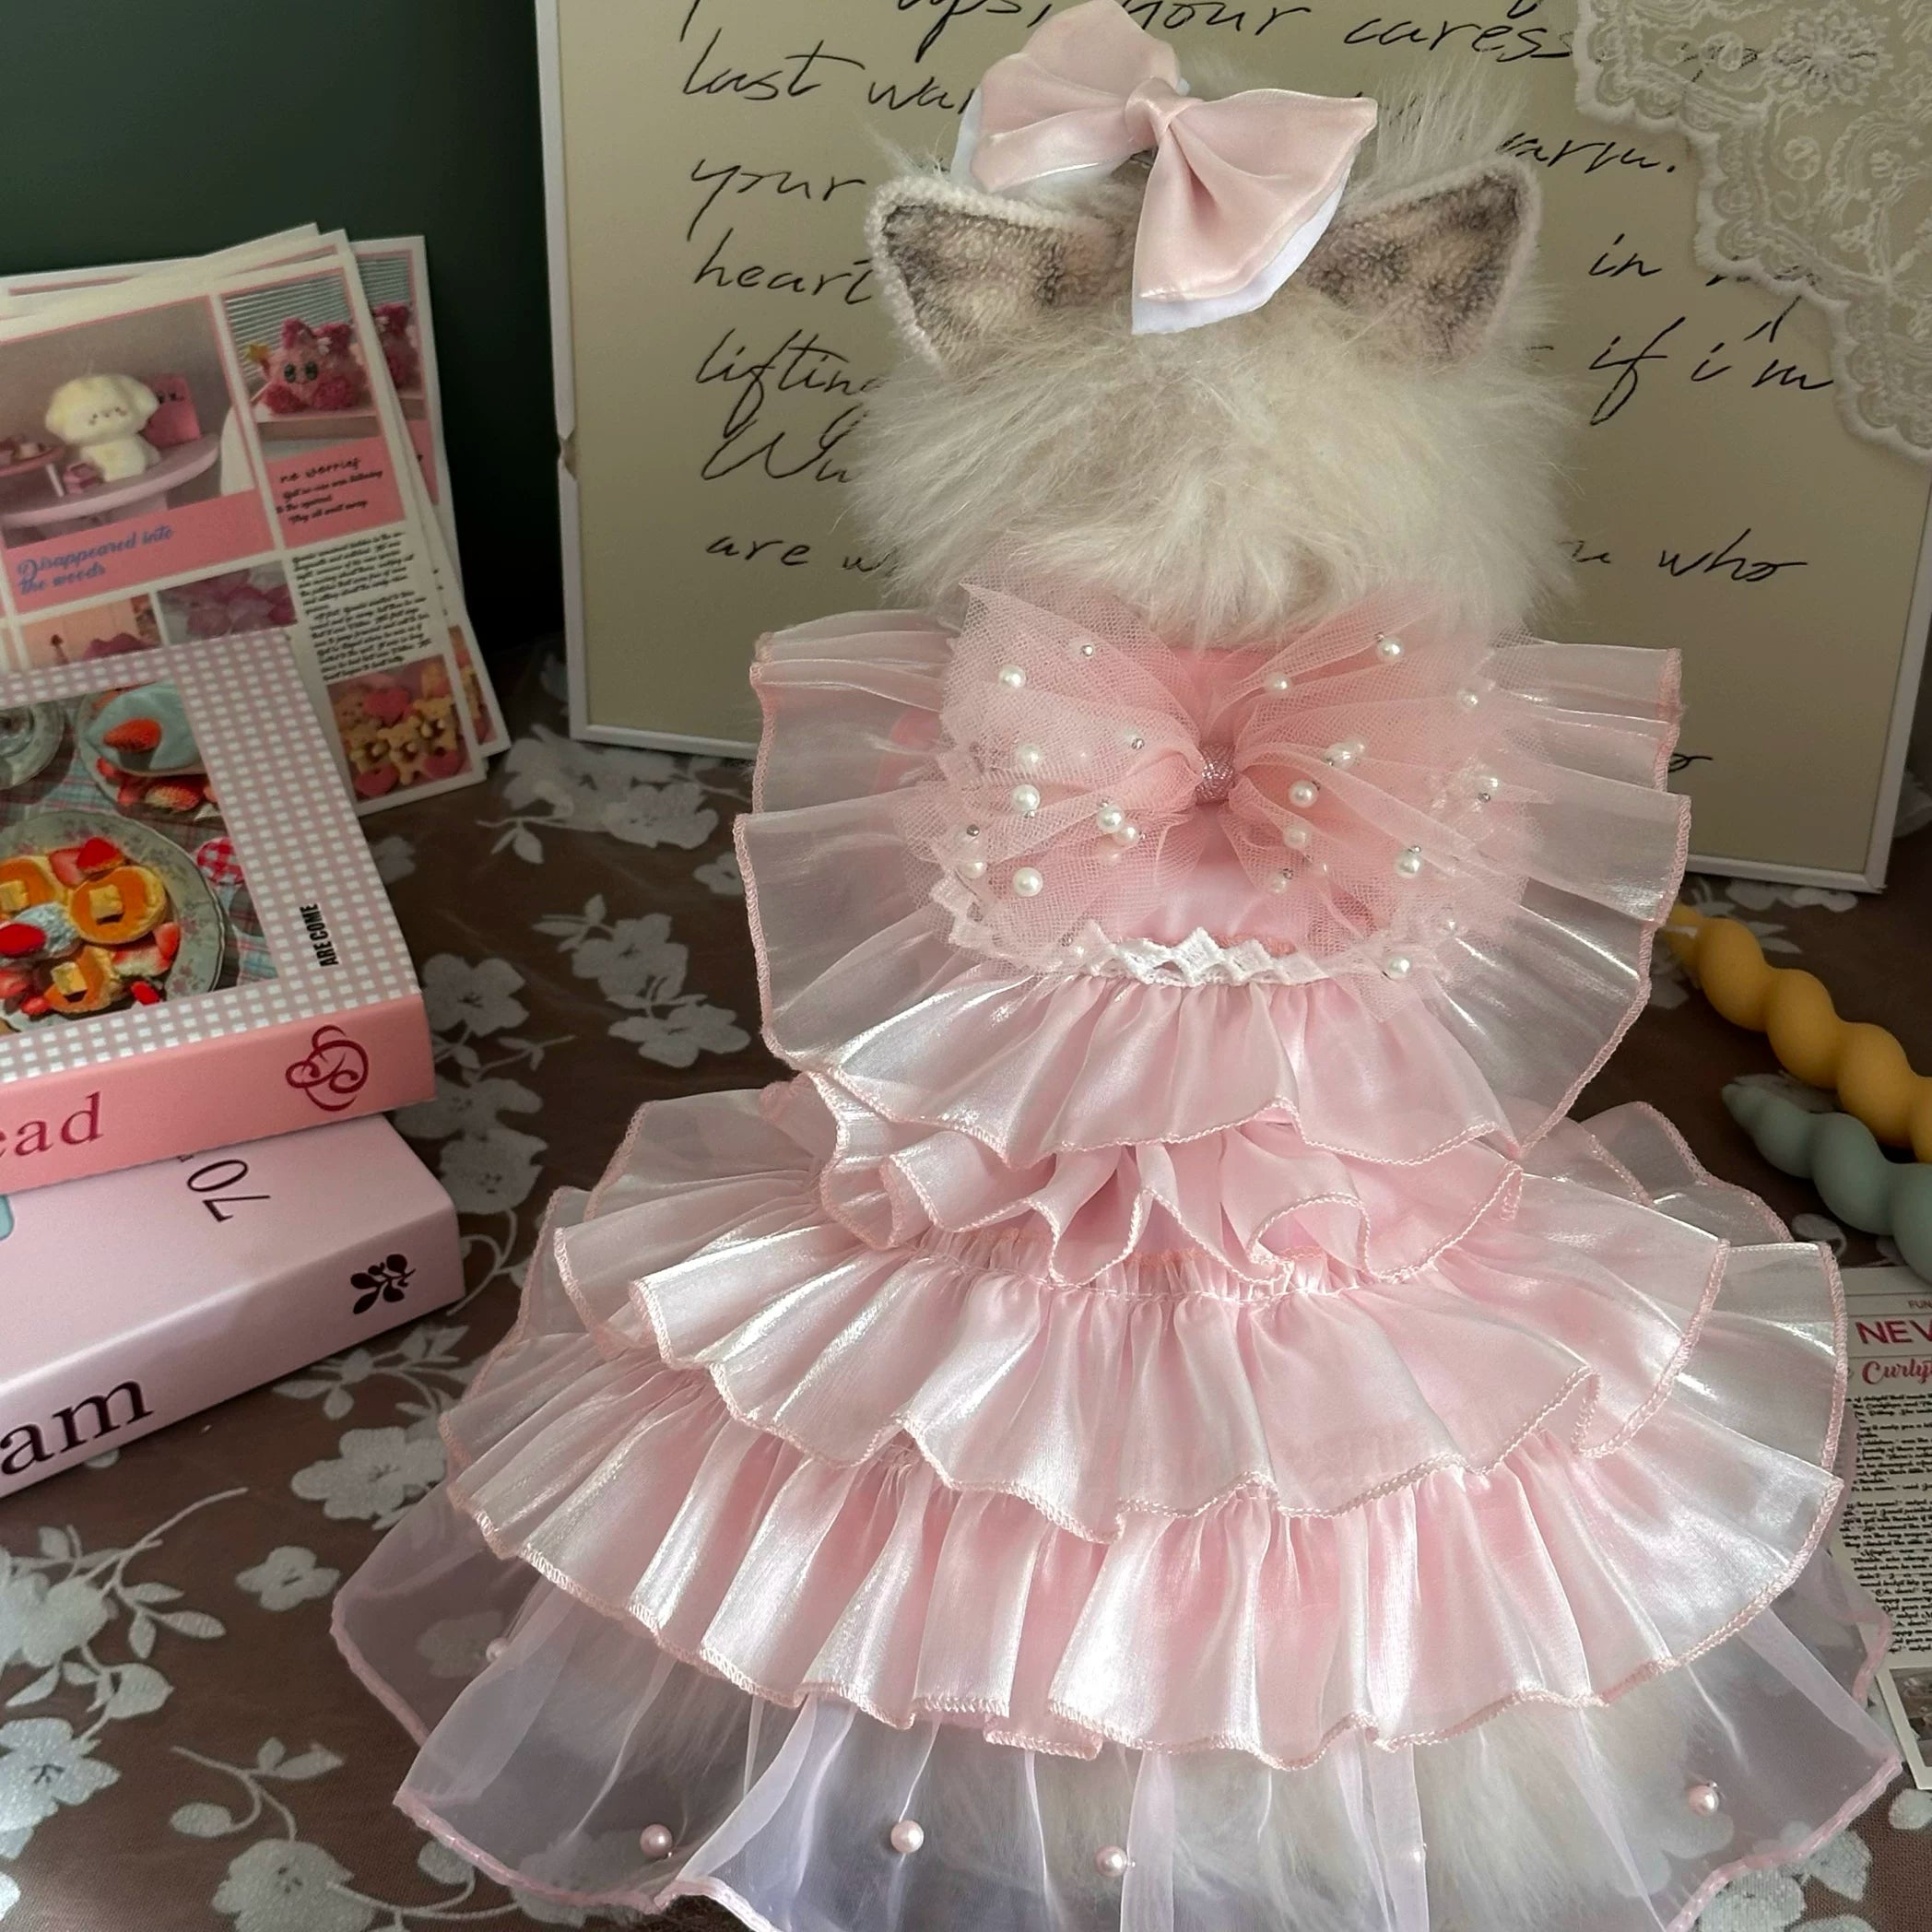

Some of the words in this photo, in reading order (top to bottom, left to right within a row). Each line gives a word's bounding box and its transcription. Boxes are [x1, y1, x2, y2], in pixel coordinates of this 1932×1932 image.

[682, 28, 865, 100] last
[687, 159, 866, 242] your
[693, 228, 874, 304] heart
[1588, 233, 1663, 277] in
[1588, 317, 1686, 426] if
[18, 533, 137, 582] Disappeared
[142, 524, 173, 547] into
[18, 576, 46, 595] the
[706, 536, 811, 565] are
[1659, 528, 1808, 582] who
[313, 941, 339, 967] ARE
